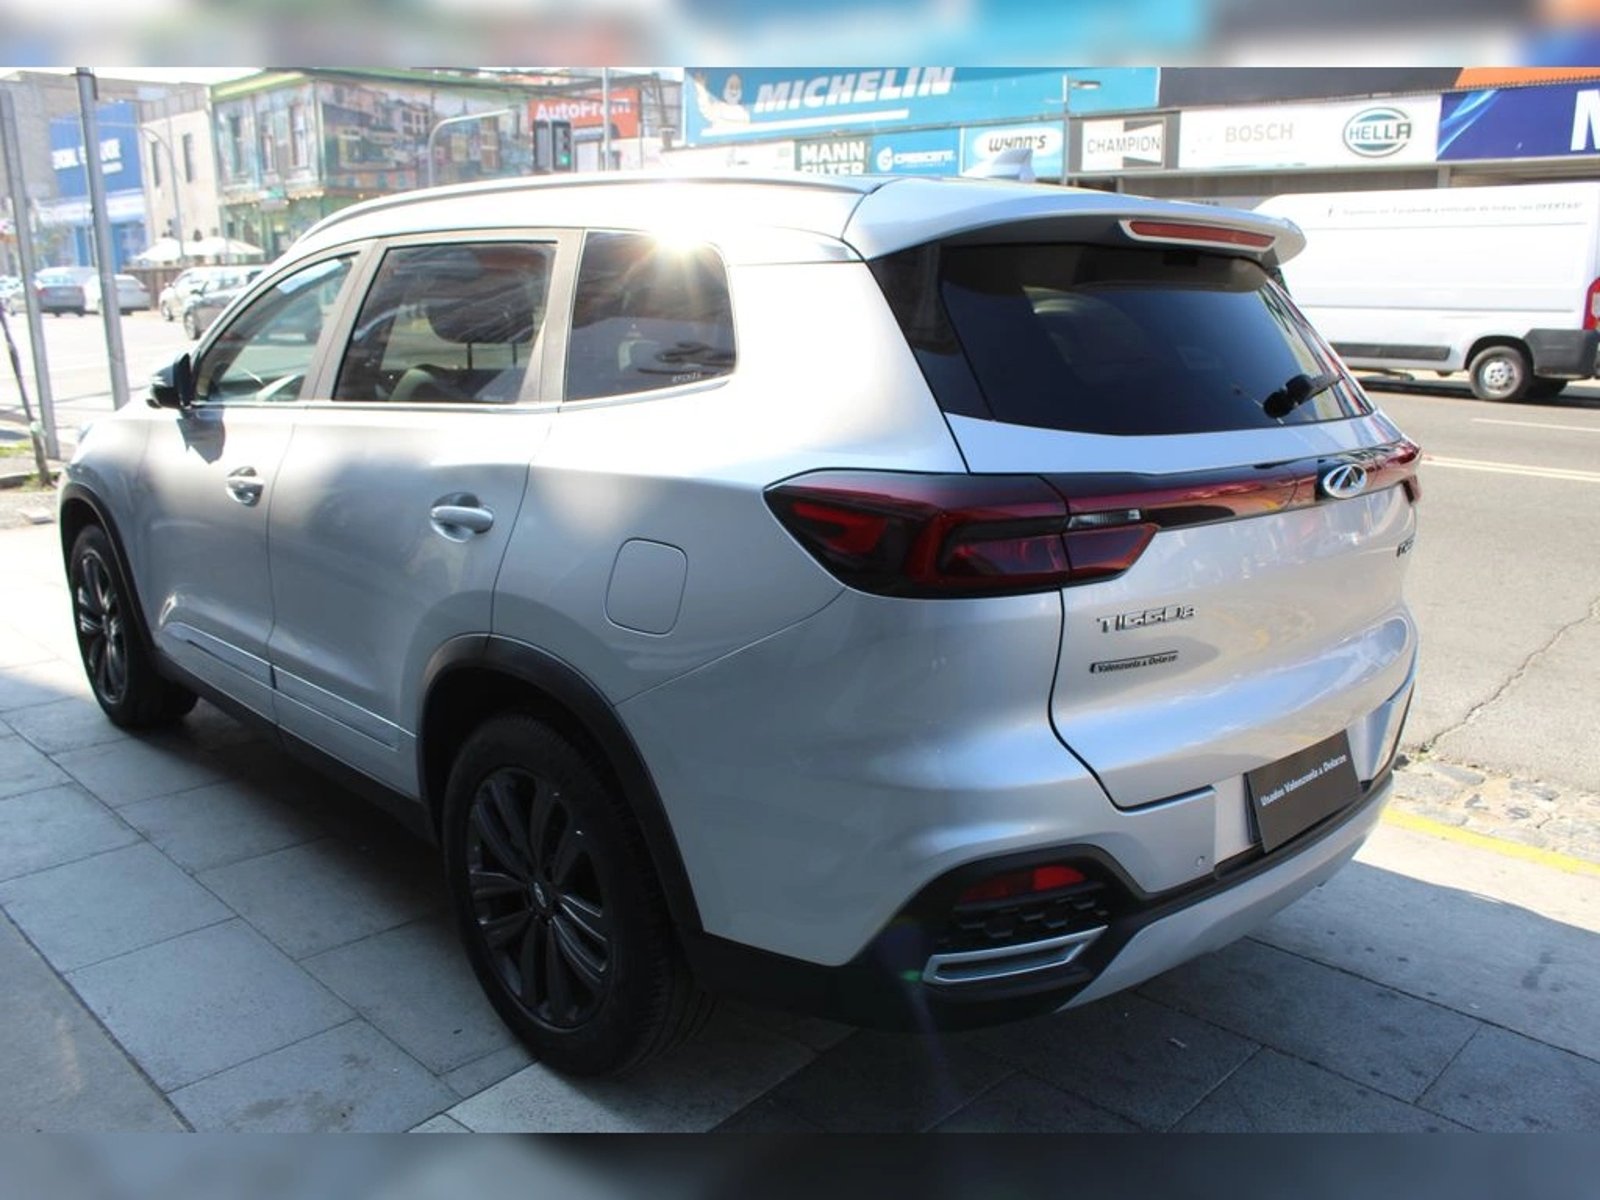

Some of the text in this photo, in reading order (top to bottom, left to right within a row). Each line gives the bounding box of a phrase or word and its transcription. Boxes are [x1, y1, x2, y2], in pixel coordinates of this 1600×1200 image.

[753, 67, 955, 113] MICHELIN
[1225, 122, 1294, 143] BOSCH
[1349, 122, 1411, 140] HELLA
[800, 140, 865, 164] MANN
[1087, 136, 1162, 154] CHAMPION
[801, 161, 864, 176] FILTER
